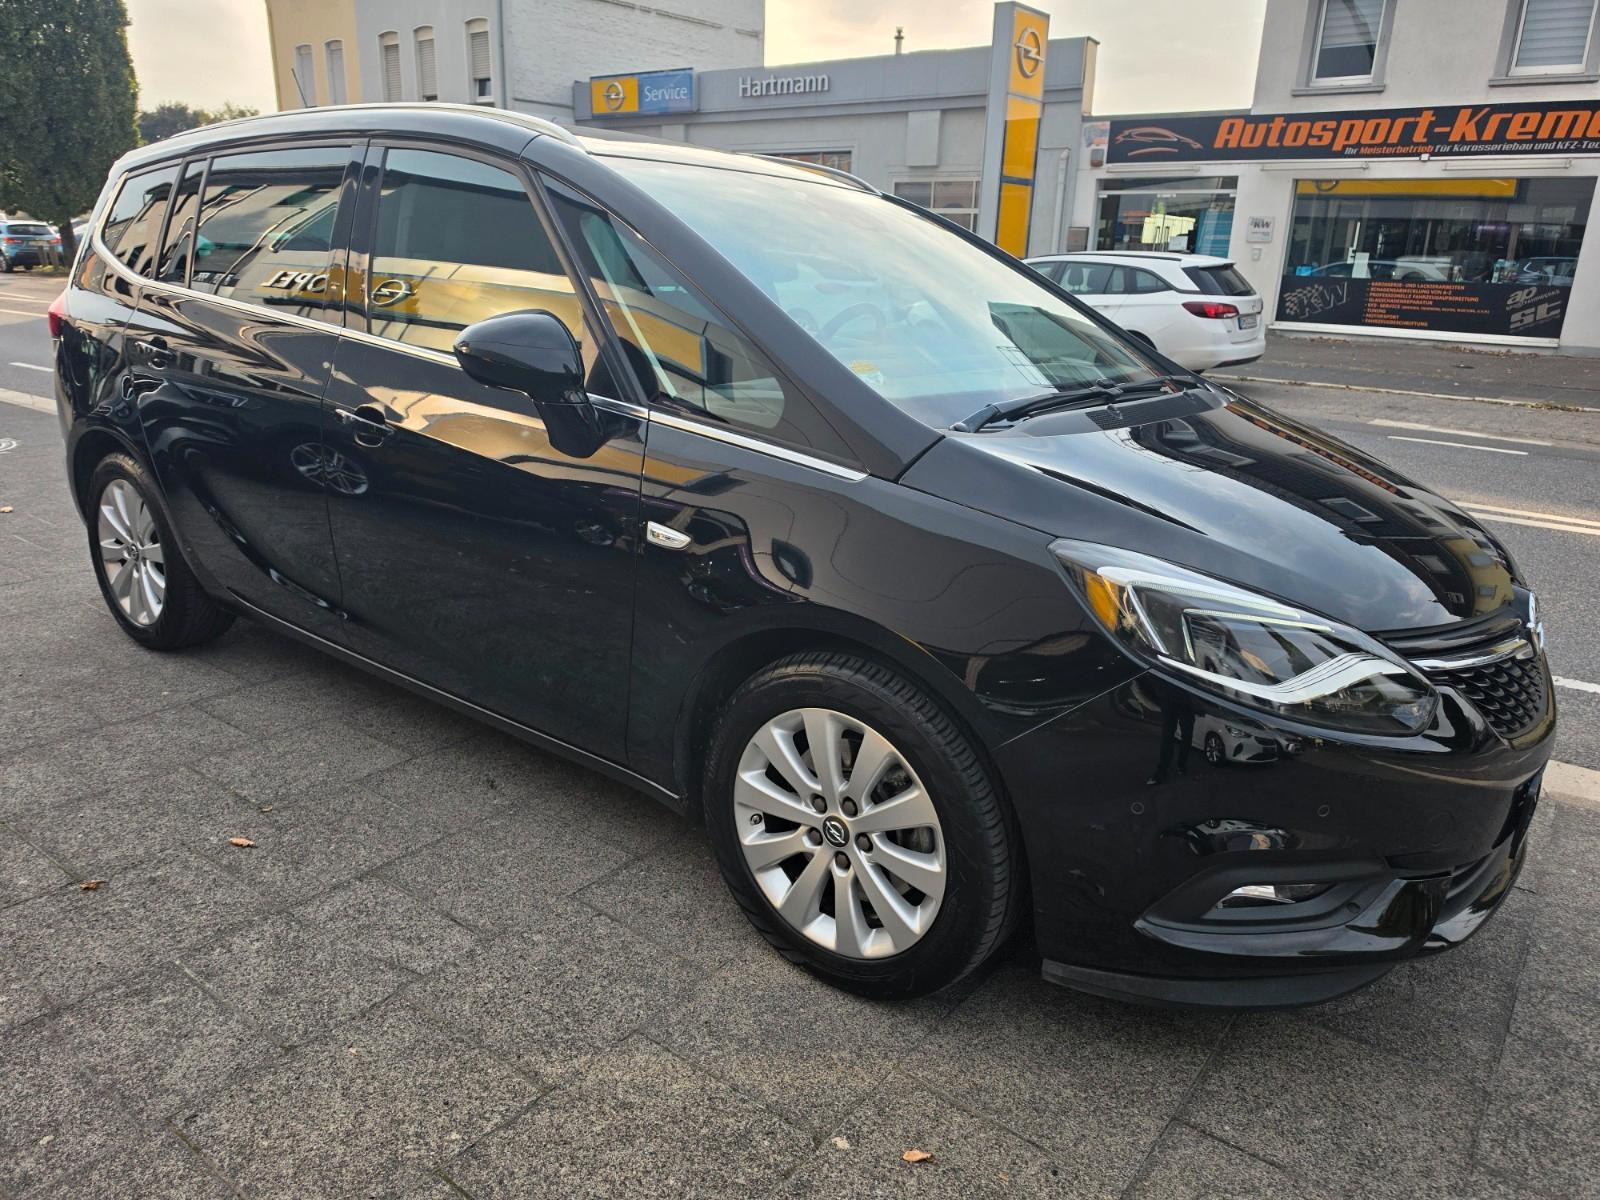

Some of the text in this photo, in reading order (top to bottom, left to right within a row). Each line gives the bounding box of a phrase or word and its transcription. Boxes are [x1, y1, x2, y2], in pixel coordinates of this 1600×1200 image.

[644, 85, 688, 102] Service
[738, 73, 829, 97] Hartmann
[1344, 147, 1358, 155] Ihr
[1359, 145, 1433, 155] Meisterbetrieb
[1453, 142, 1533, 152] Karosseriebau
[1534, 141, 1556, 151] und
